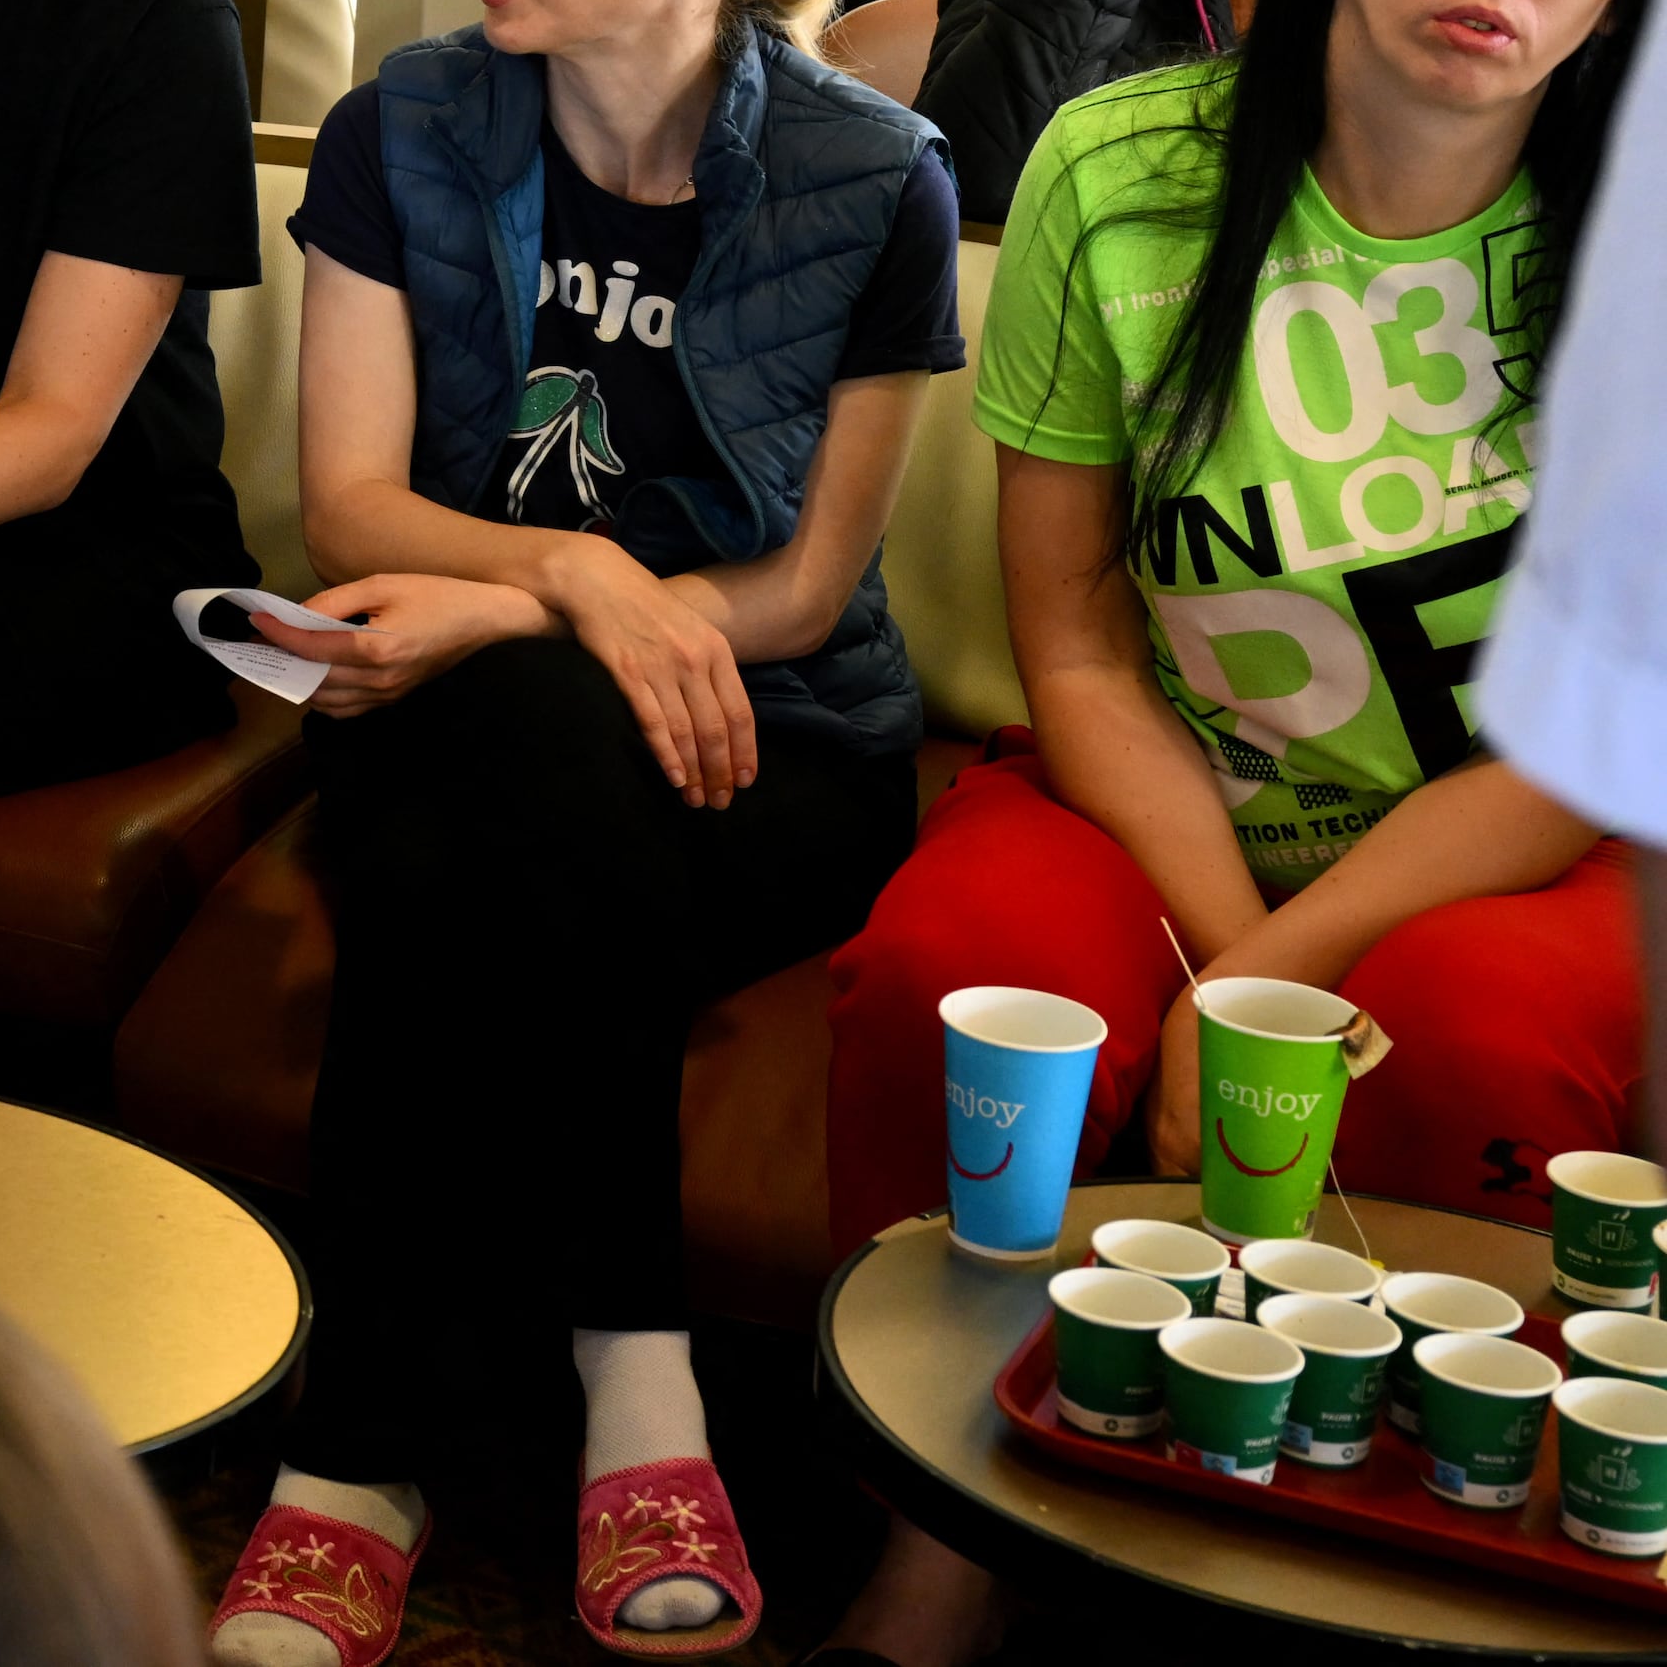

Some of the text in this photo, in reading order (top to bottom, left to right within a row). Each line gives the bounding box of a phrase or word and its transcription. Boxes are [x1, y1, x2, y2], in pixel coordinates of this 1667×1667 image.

[1445, 482, 1480, 496] SERIAL
[1234, 822, 1300, 845] TION
[946, 1075, 1026, 1129] enjoy
[1218, 1079, 1323, 1121] enjoy
